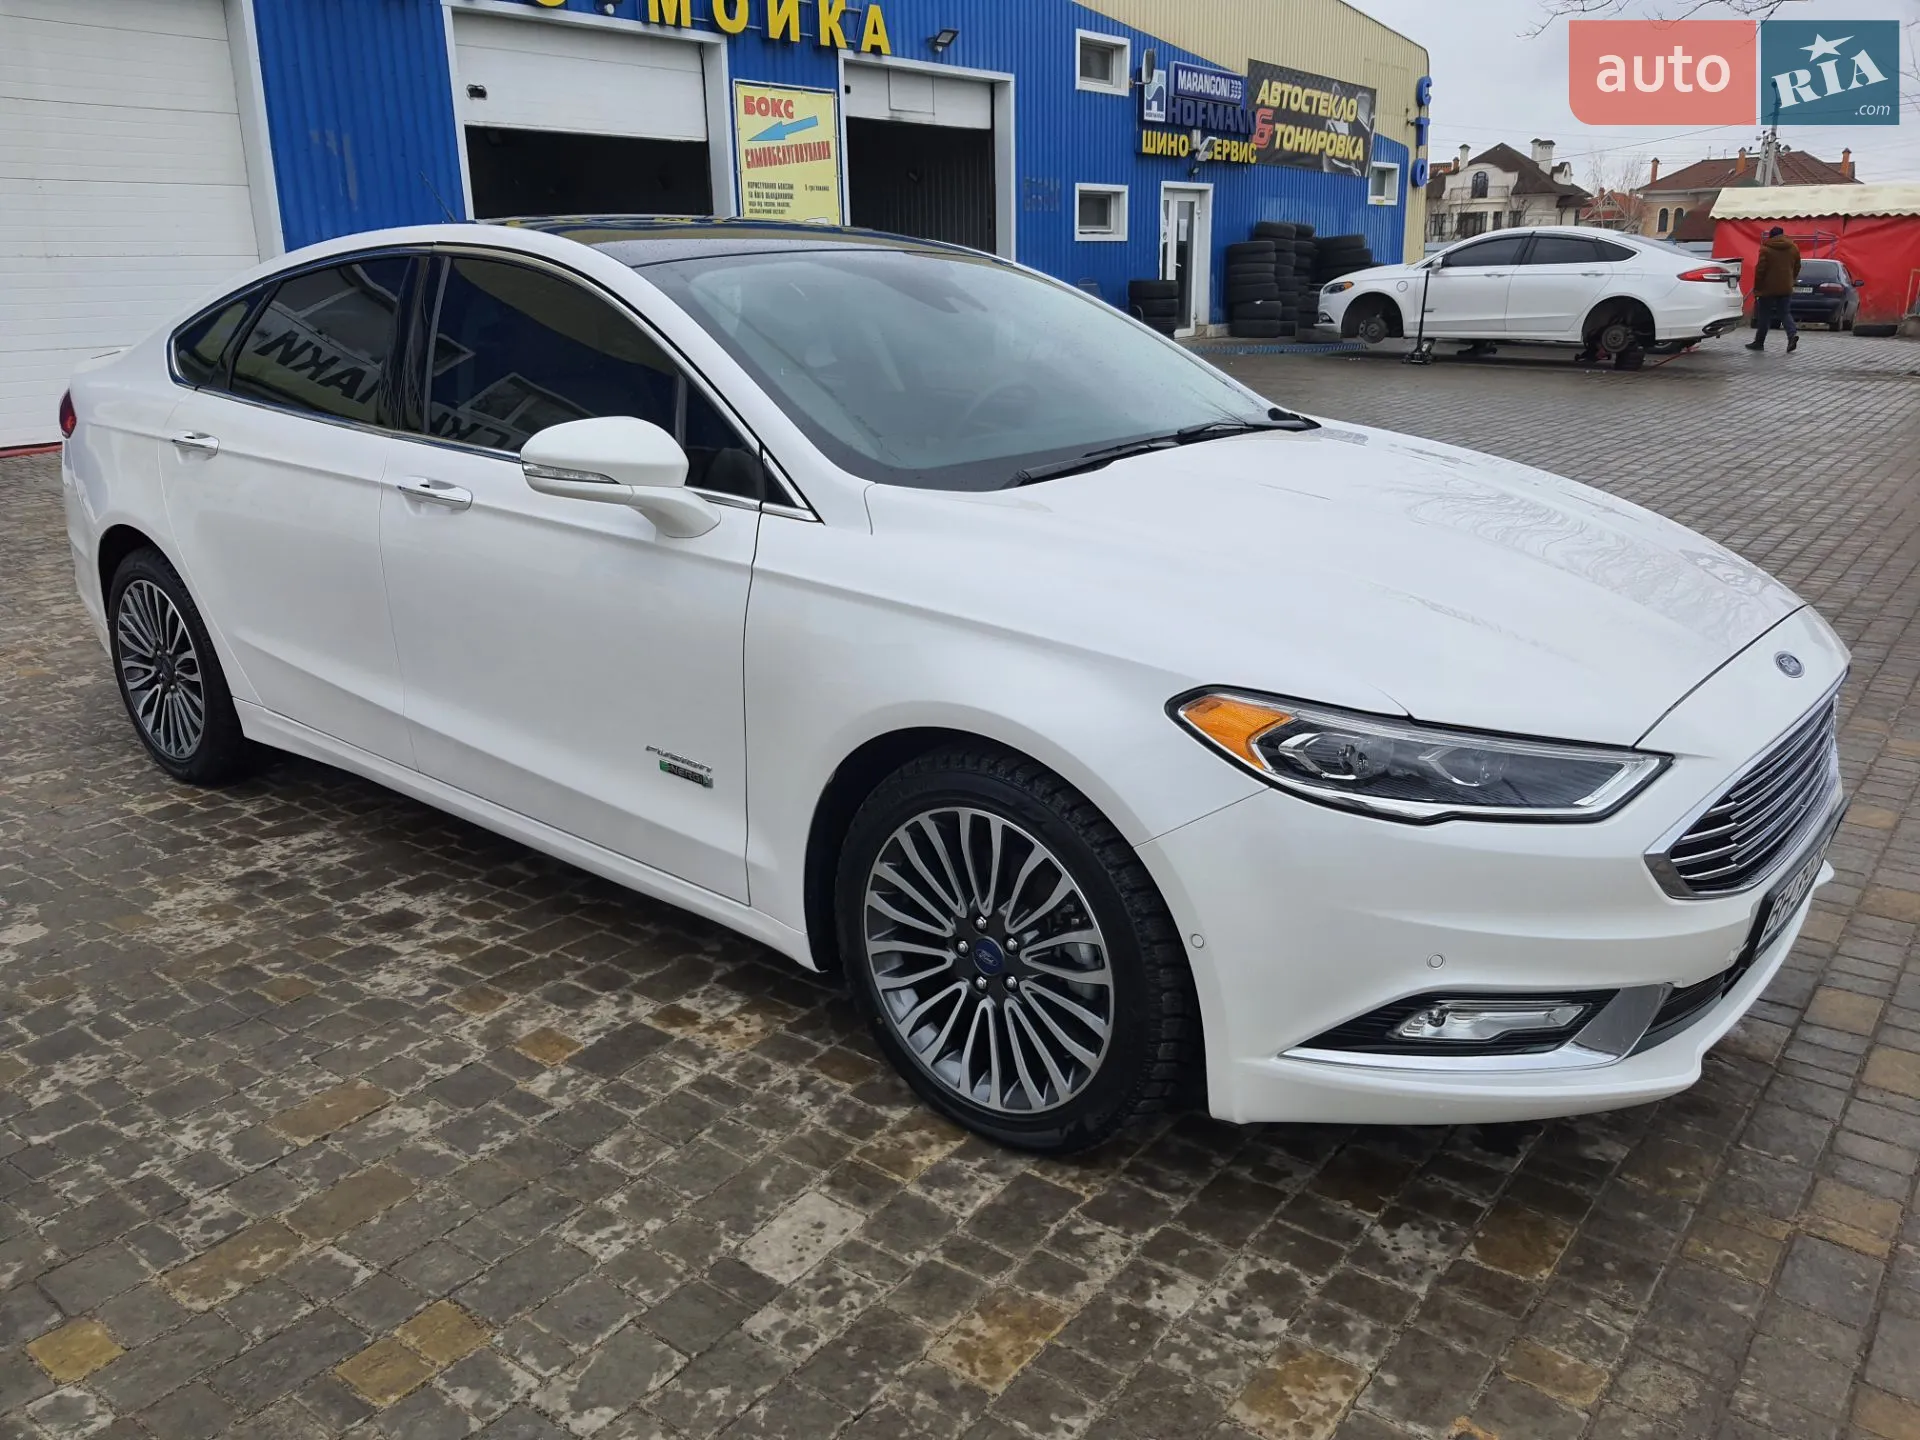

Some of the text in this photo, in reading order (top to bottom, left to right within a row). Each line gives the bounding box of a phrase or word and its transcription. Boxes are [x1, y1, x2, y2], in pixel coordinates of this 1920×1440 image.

[1177, 69, 1231, 98] MARANGONI
[1256, 79, 1358, 122] АВТОСТЕКЛО
[743, 95, 794, 119] БОКС
[1142, 129, 1257, 164] ШИНО ЕРВИС
[1274, 123, 1364, 161] ТОНИРОВКА
